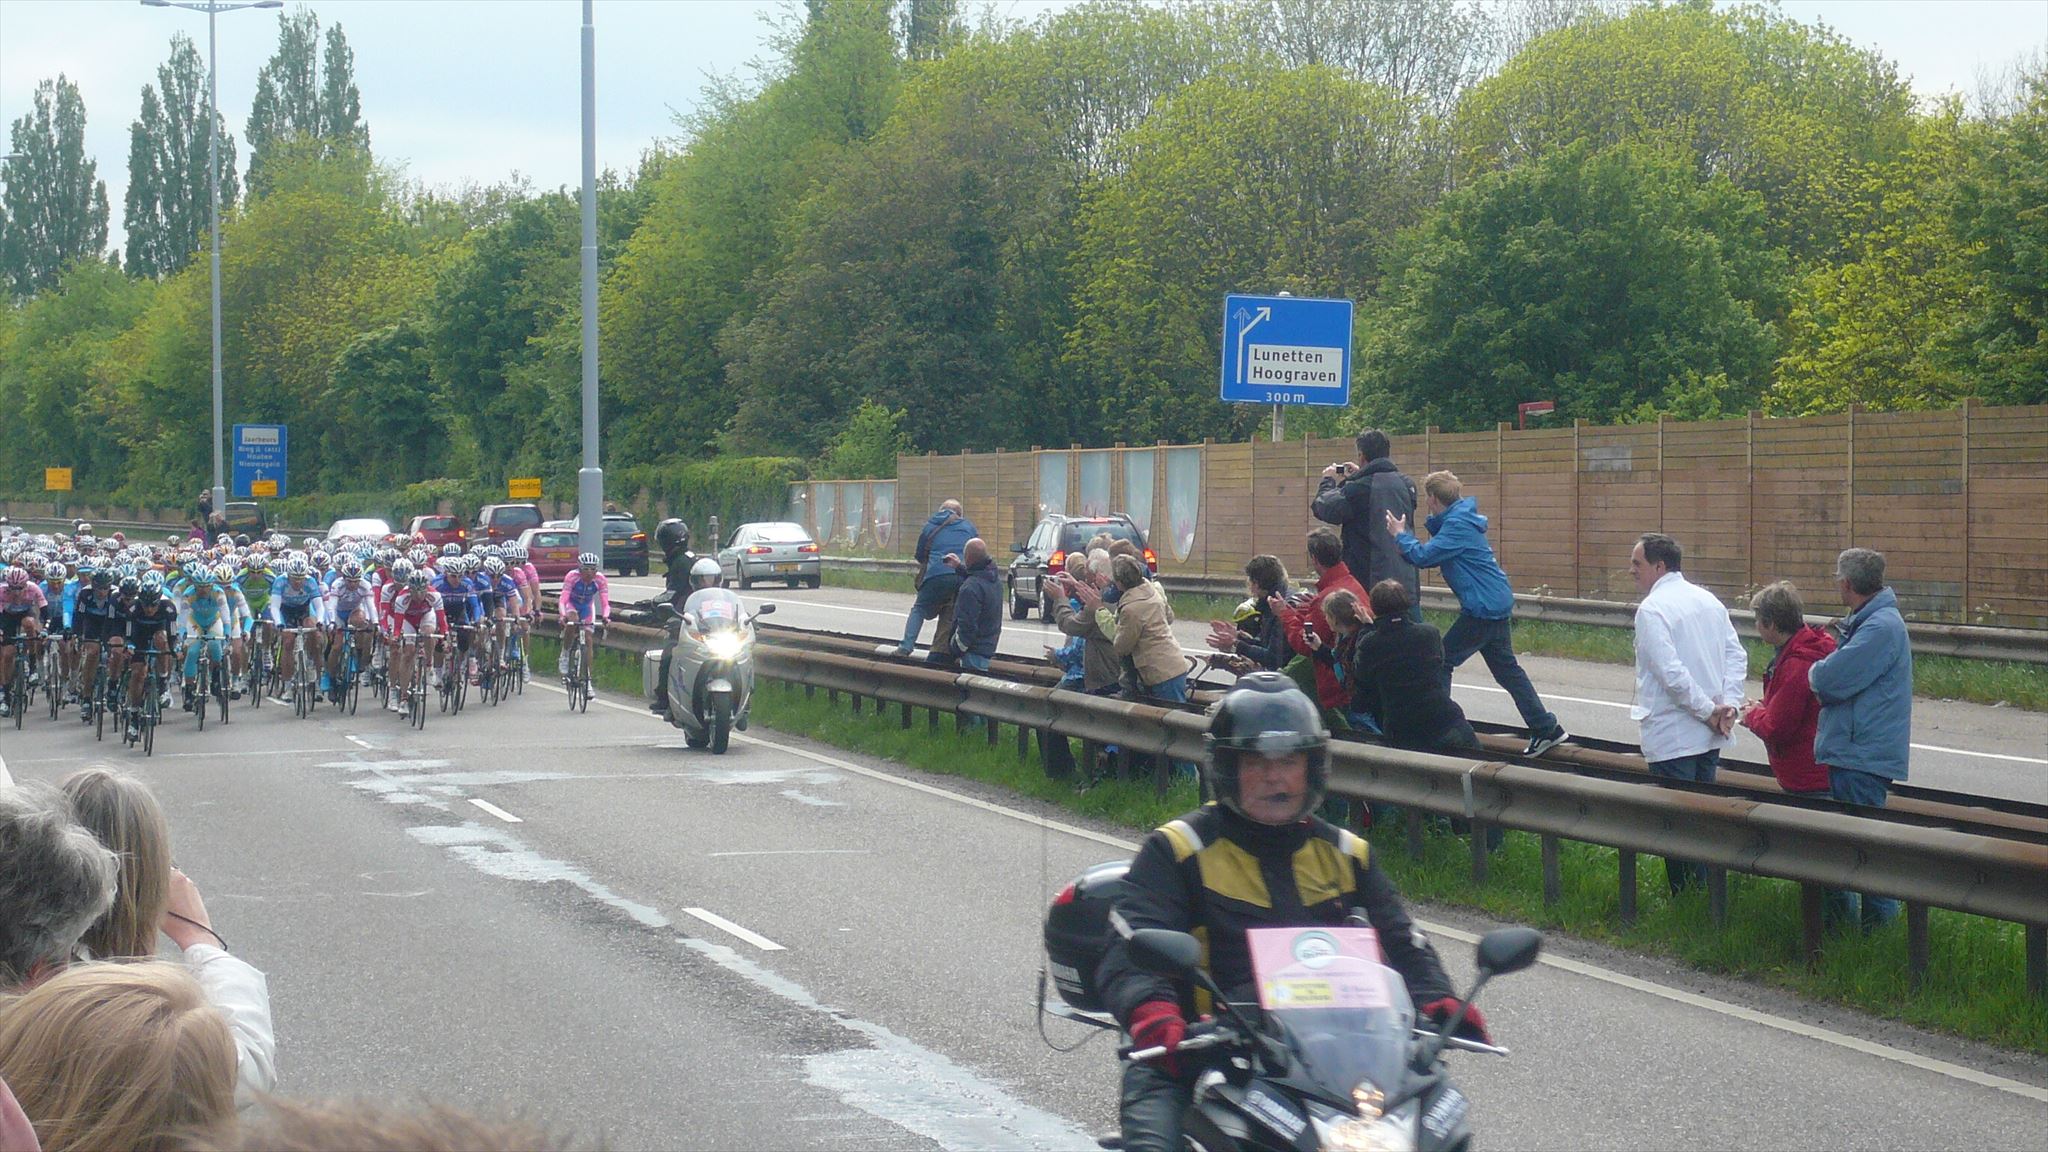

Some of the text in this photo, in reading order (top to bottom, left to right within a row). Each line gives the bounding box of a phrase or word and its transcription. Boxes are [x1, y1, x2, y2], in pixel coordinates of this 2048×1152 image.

[1254, 348, 1323, 363] Lunetten
[1253, 366, 1336, 384] Hoograven
[1266, 392, 1305, 403] 300 m
